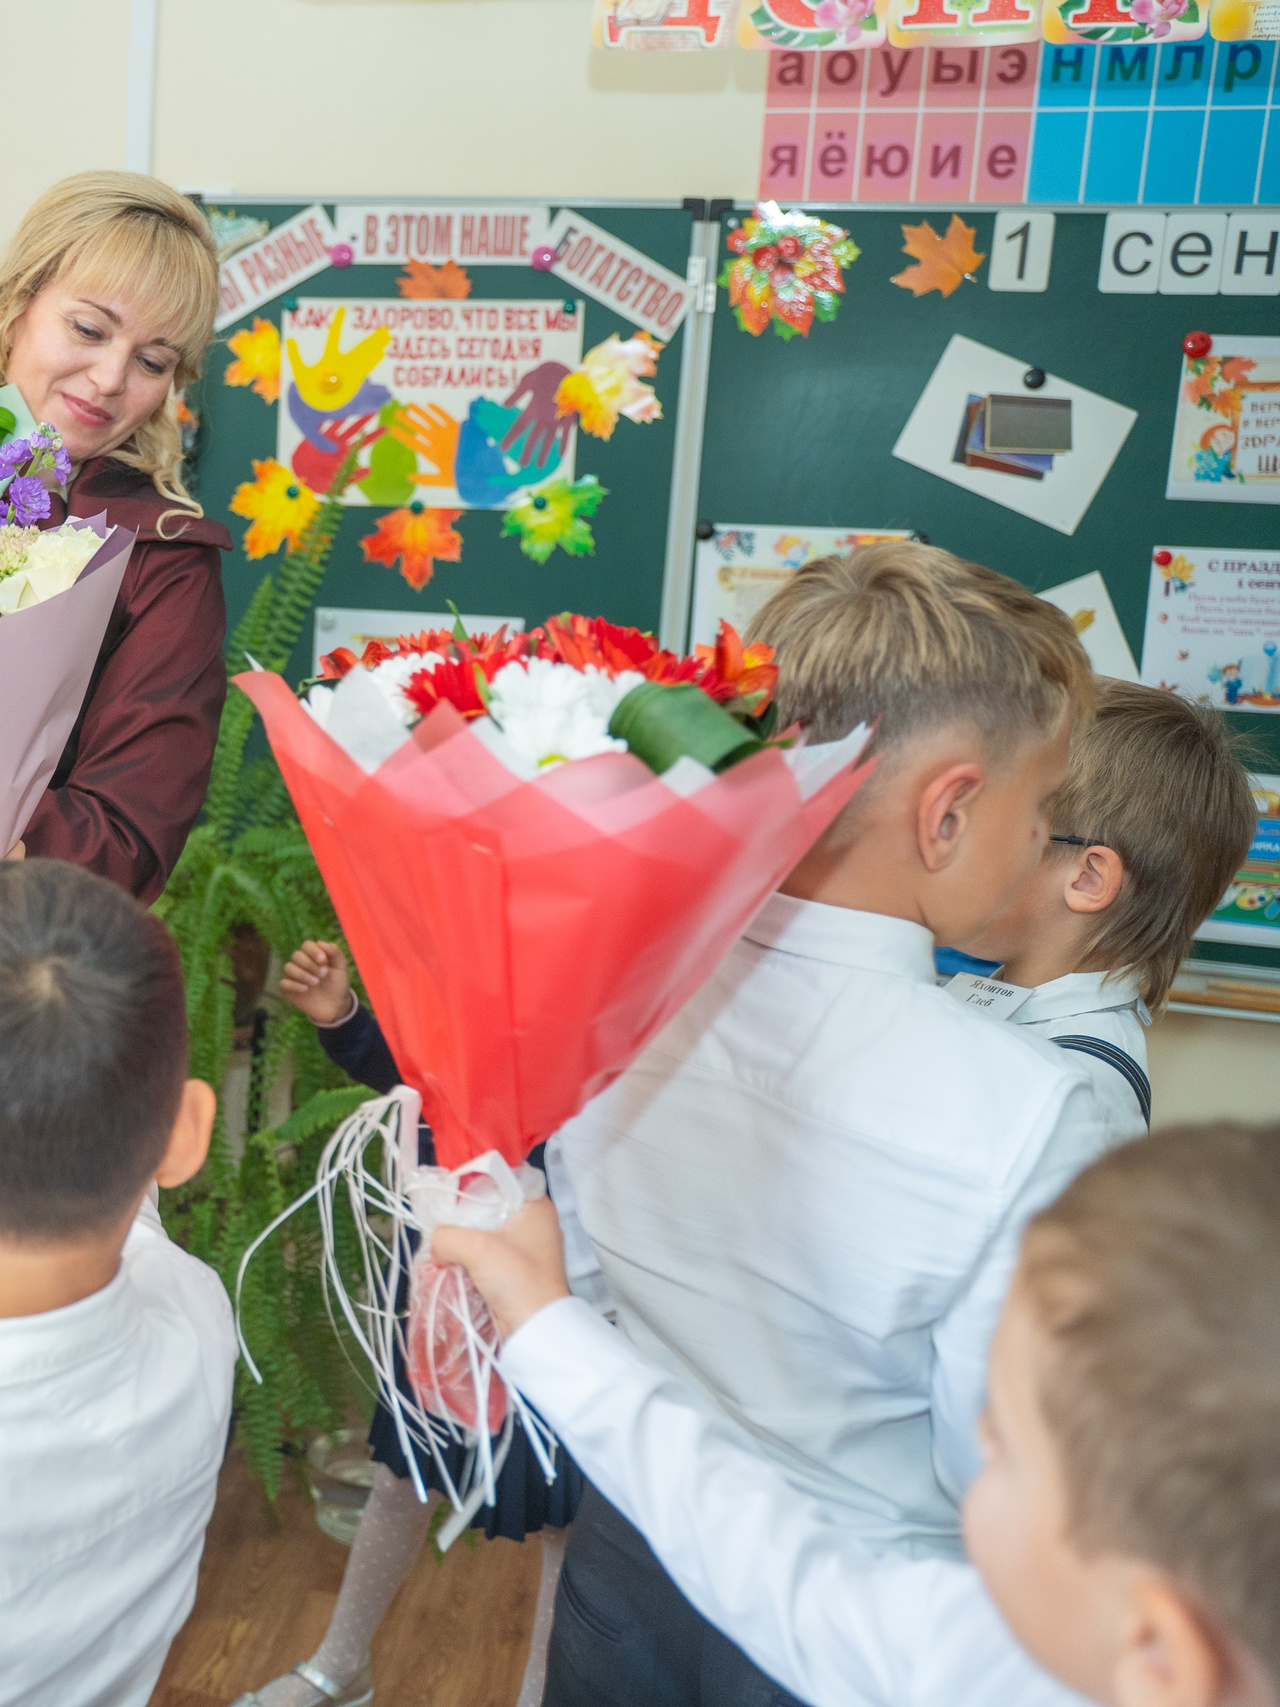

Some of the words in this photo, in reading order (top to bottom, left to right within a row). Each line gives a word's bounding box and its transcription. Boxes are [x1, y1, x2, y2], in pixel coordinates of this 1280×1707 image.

[364, 213, 379, 255] В
[385, 213, 453, 256] ЭТОМ
[459, 214, 531, 257] НАШЕ
[1005, 220, 1032, 281] 1
[240, 218, 332, 298] РАЗНЫЕ
[461, 306, 499, 331] ЧТО
[504, 306, 539, 331] ВСЕ
[545, 307, 578, 332] МЫ
[387, 335, 451, 361] ЗДЕСЬ
[456, 336, 542, 361] СЕГОДНЯ
